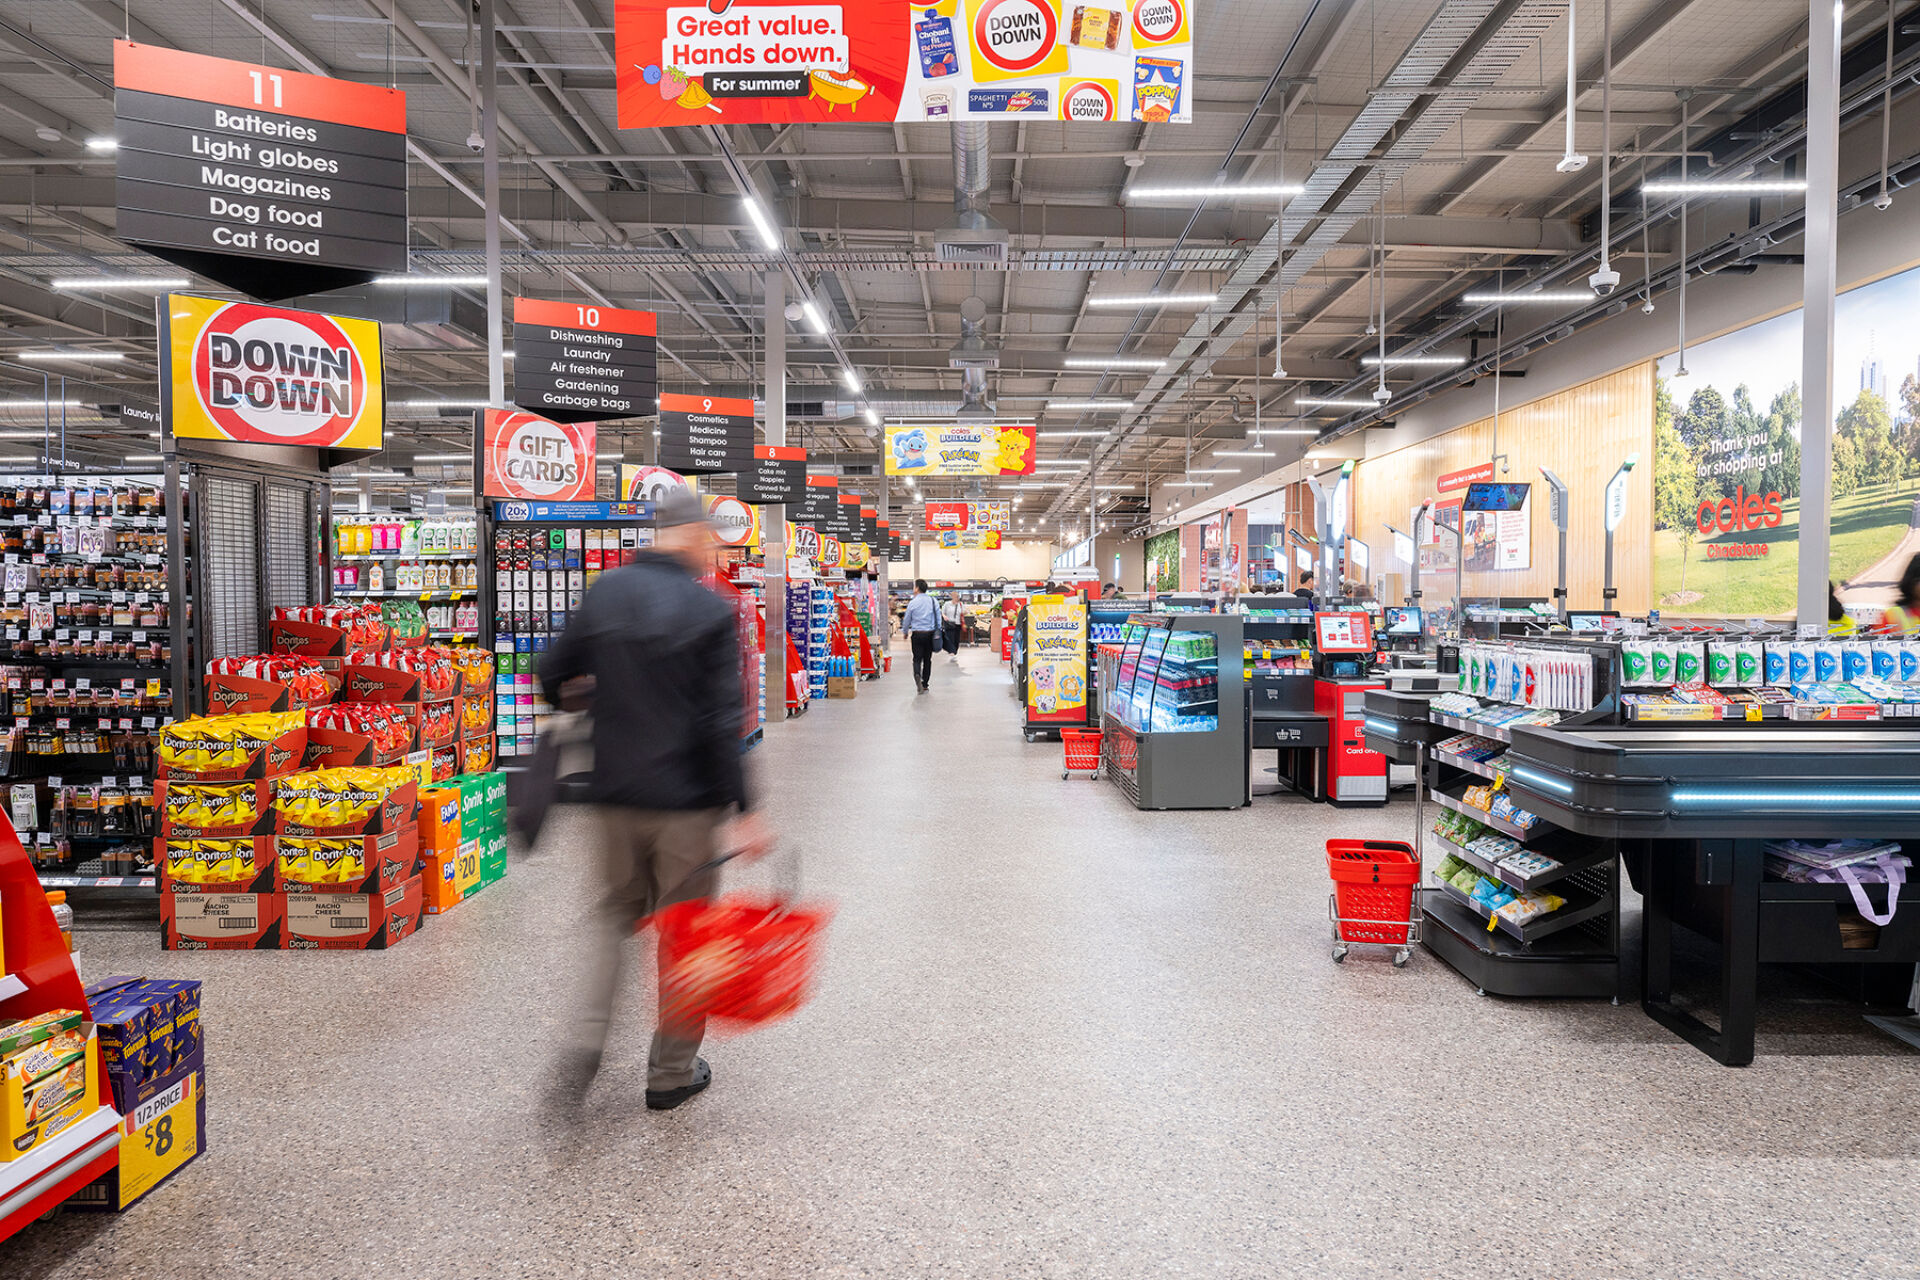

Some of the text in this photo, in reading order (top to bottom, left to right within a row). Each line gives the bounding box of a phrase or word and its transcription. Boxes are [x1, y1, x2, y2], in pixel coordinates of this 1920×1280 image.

[1141, 5, 1173, 18] DOWN
[677, 15, 836, 37] Great value.
[990, 12, 1041, 32] DOWN
[1143, 13, 1174, 27] DOWN
[918, 28, 950, 39] Chobani
[992, 27, 1042, 47] DOWN
[672, 43, 842, 65] Hands down.
[249, 71, 282, 108] 11
[712, 78, 801, 91] For summer
[969, 94, 1008, 103] SPAGHETTI
[1072, 98, 1104, 109] DOWN
[1072, 107, 1104, 118] DOWN
[215, 110, 317, 142] Batteries
[192, 135, 338, 173] Light globes
[202, 166, 331, 201] Magazines
[210, 197, 322, 228] Dog food
[212, 227, 320, 256] Cat food
[577, 307, 600, 327] 10
[550, 330, 623, 348] Dishwashing
[209, 334, 351, 381] DOWN
[564, 347, 611, 362] Laundry
[550, 362, 624, 377] Air freshener
[210, 371, 351, 417] DOWN
[555, 379, 619, 395] Gardening
[543, 393, 631, 411] Garbage bags
[703, 399, 712, 412] 9
[123, 405, 154, 421] Laundry
[687, 414, 729, 425] Cosmetics
[689, 426, 727, 435] Medicine
[519, 435, 566, 460] GIFT
[689, 436, 727, 446] Shampoo
[1711, 431, 1768, 454] Thank you
[690, 448, 706, 456] Hair
[769, 448, 775, 458] 8
[695, 459, 722, 467] Dental
[1697, 450, 1783, 477] for shopping at
[506, 458, 578, 484] CARDS
[507, 506, 527, 516] 20x
[1696, 485, 1783, 534] coles
[795, 528, 816, 546] 1/2
[796, 547, 816, 556] PRICE
[1707, 542, 1769, 558] Chadstone
[825, 554, 838, 562] RICE
[1036, 621, 1079, 630] BUILDERS
[277, 636, 309, 646] Doritos
[352, 681, 384, 690] Doritos
[213, 692, 249, 701] Doritos
[164, 737, 197, 750] Doritos
[270, 752, 291, 763] Doritos
[167, 771, 197, 780] Doritos
[343, 791, 378, 801] Doritos
[487, 781, 506, 803] Sprite
[202, 796, 233, 807] Doritos
[462, 790, 483, 814] Sprite
[385, 805, 403, 819] Doritos
[441, 800, 458, 821] FANTA
[171, 828, 202, 836] Doritos
[284, 827, 314, 835] Doritos
[487, 834, 507, 857] Sprite
[194, 850, 232, 861] Doritos
[383, 862, 402, 877] Doritos
[459, 854, 475, 879] $20
[171, 884, 201, 892] Doritos
[283, 884, 312, 892] Doritos
[389, 915, 409, 933] Doritos
[177, 941, 208, 949] Doritos
[289, 940, 319, 948] Doritos
[149, 1021, 175, 1043] Favourites
[122, 1034, 148, 1059] Favourites
[136, 1087, 180, 1125] 1/2 PRICE
[144, 1114, 173, 1157] $8
